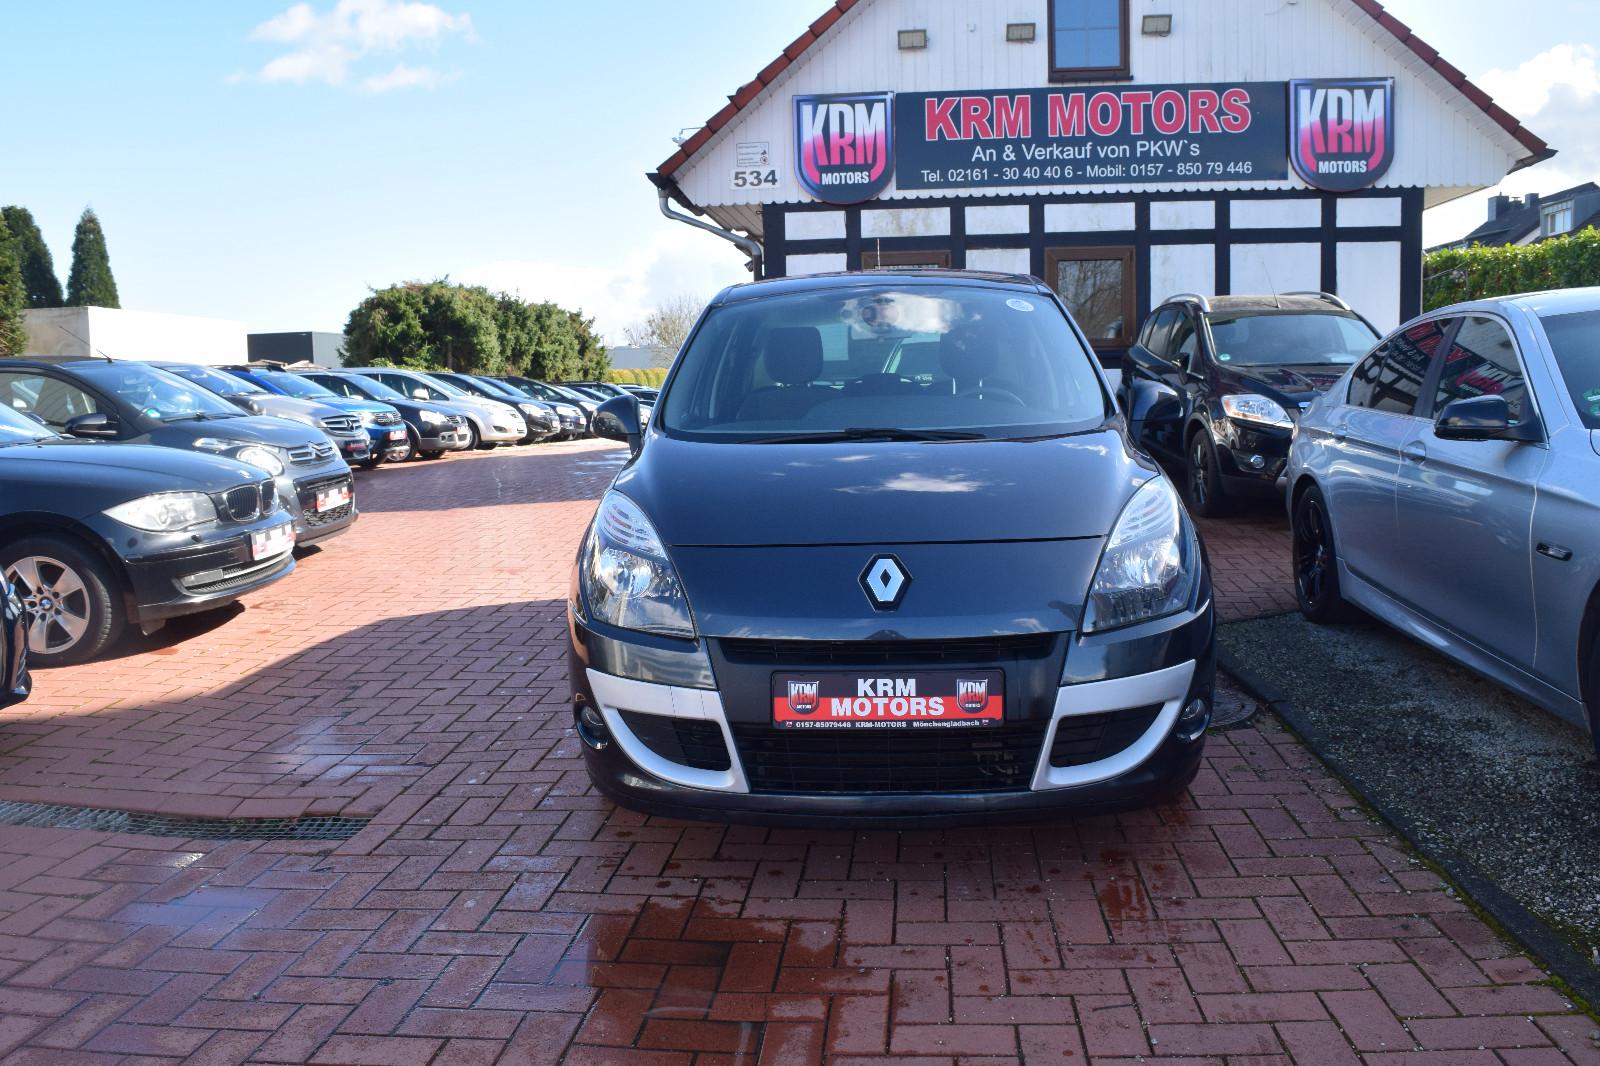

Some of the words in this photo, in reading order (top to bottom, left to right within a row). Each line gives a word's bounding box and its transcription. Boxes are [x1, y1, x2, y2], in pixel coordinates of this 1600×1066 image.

[925, 94, 1032, 141] KRM
[1047, 88, 1252, 138] MOTORS
[1300, 88, 1385, 172] KRM
[802, 102, 886, 184] KRM
[971, 145, 997, 162] An
[1002, 144, 1017, 161] &
[1022, 142, 1093, 161] Verkauf
[1096, 145, 1130, 159] von
[921, 170, 944, 182] Tel.
[947, 168, 989, 182] 02161
[1002, 167, 1019, 180] 30
[1022, 166, 1040, 179] 40
[1043, 165, 1061, 178] 40
[1064, 165, 1073, 178] 6
[1086, 164, 1126, 178] Mobil:
[1130, 163, 1164, 176] 0157
[1177, 162, 1202, 175] 850
[1206, 162, 1223, 175] 79
[1226, 161, 1253, 174] 446
[1318, 160, 1367, 174] MOTORS
[733, 169, 778, 188] 534
[821, 171, 870, 185] MOTORS
[857, 678, 916, 697] KRM
[831, 697, 945, 717] MOTORS
[912, 719, 980, 728] Mönchengladbach
